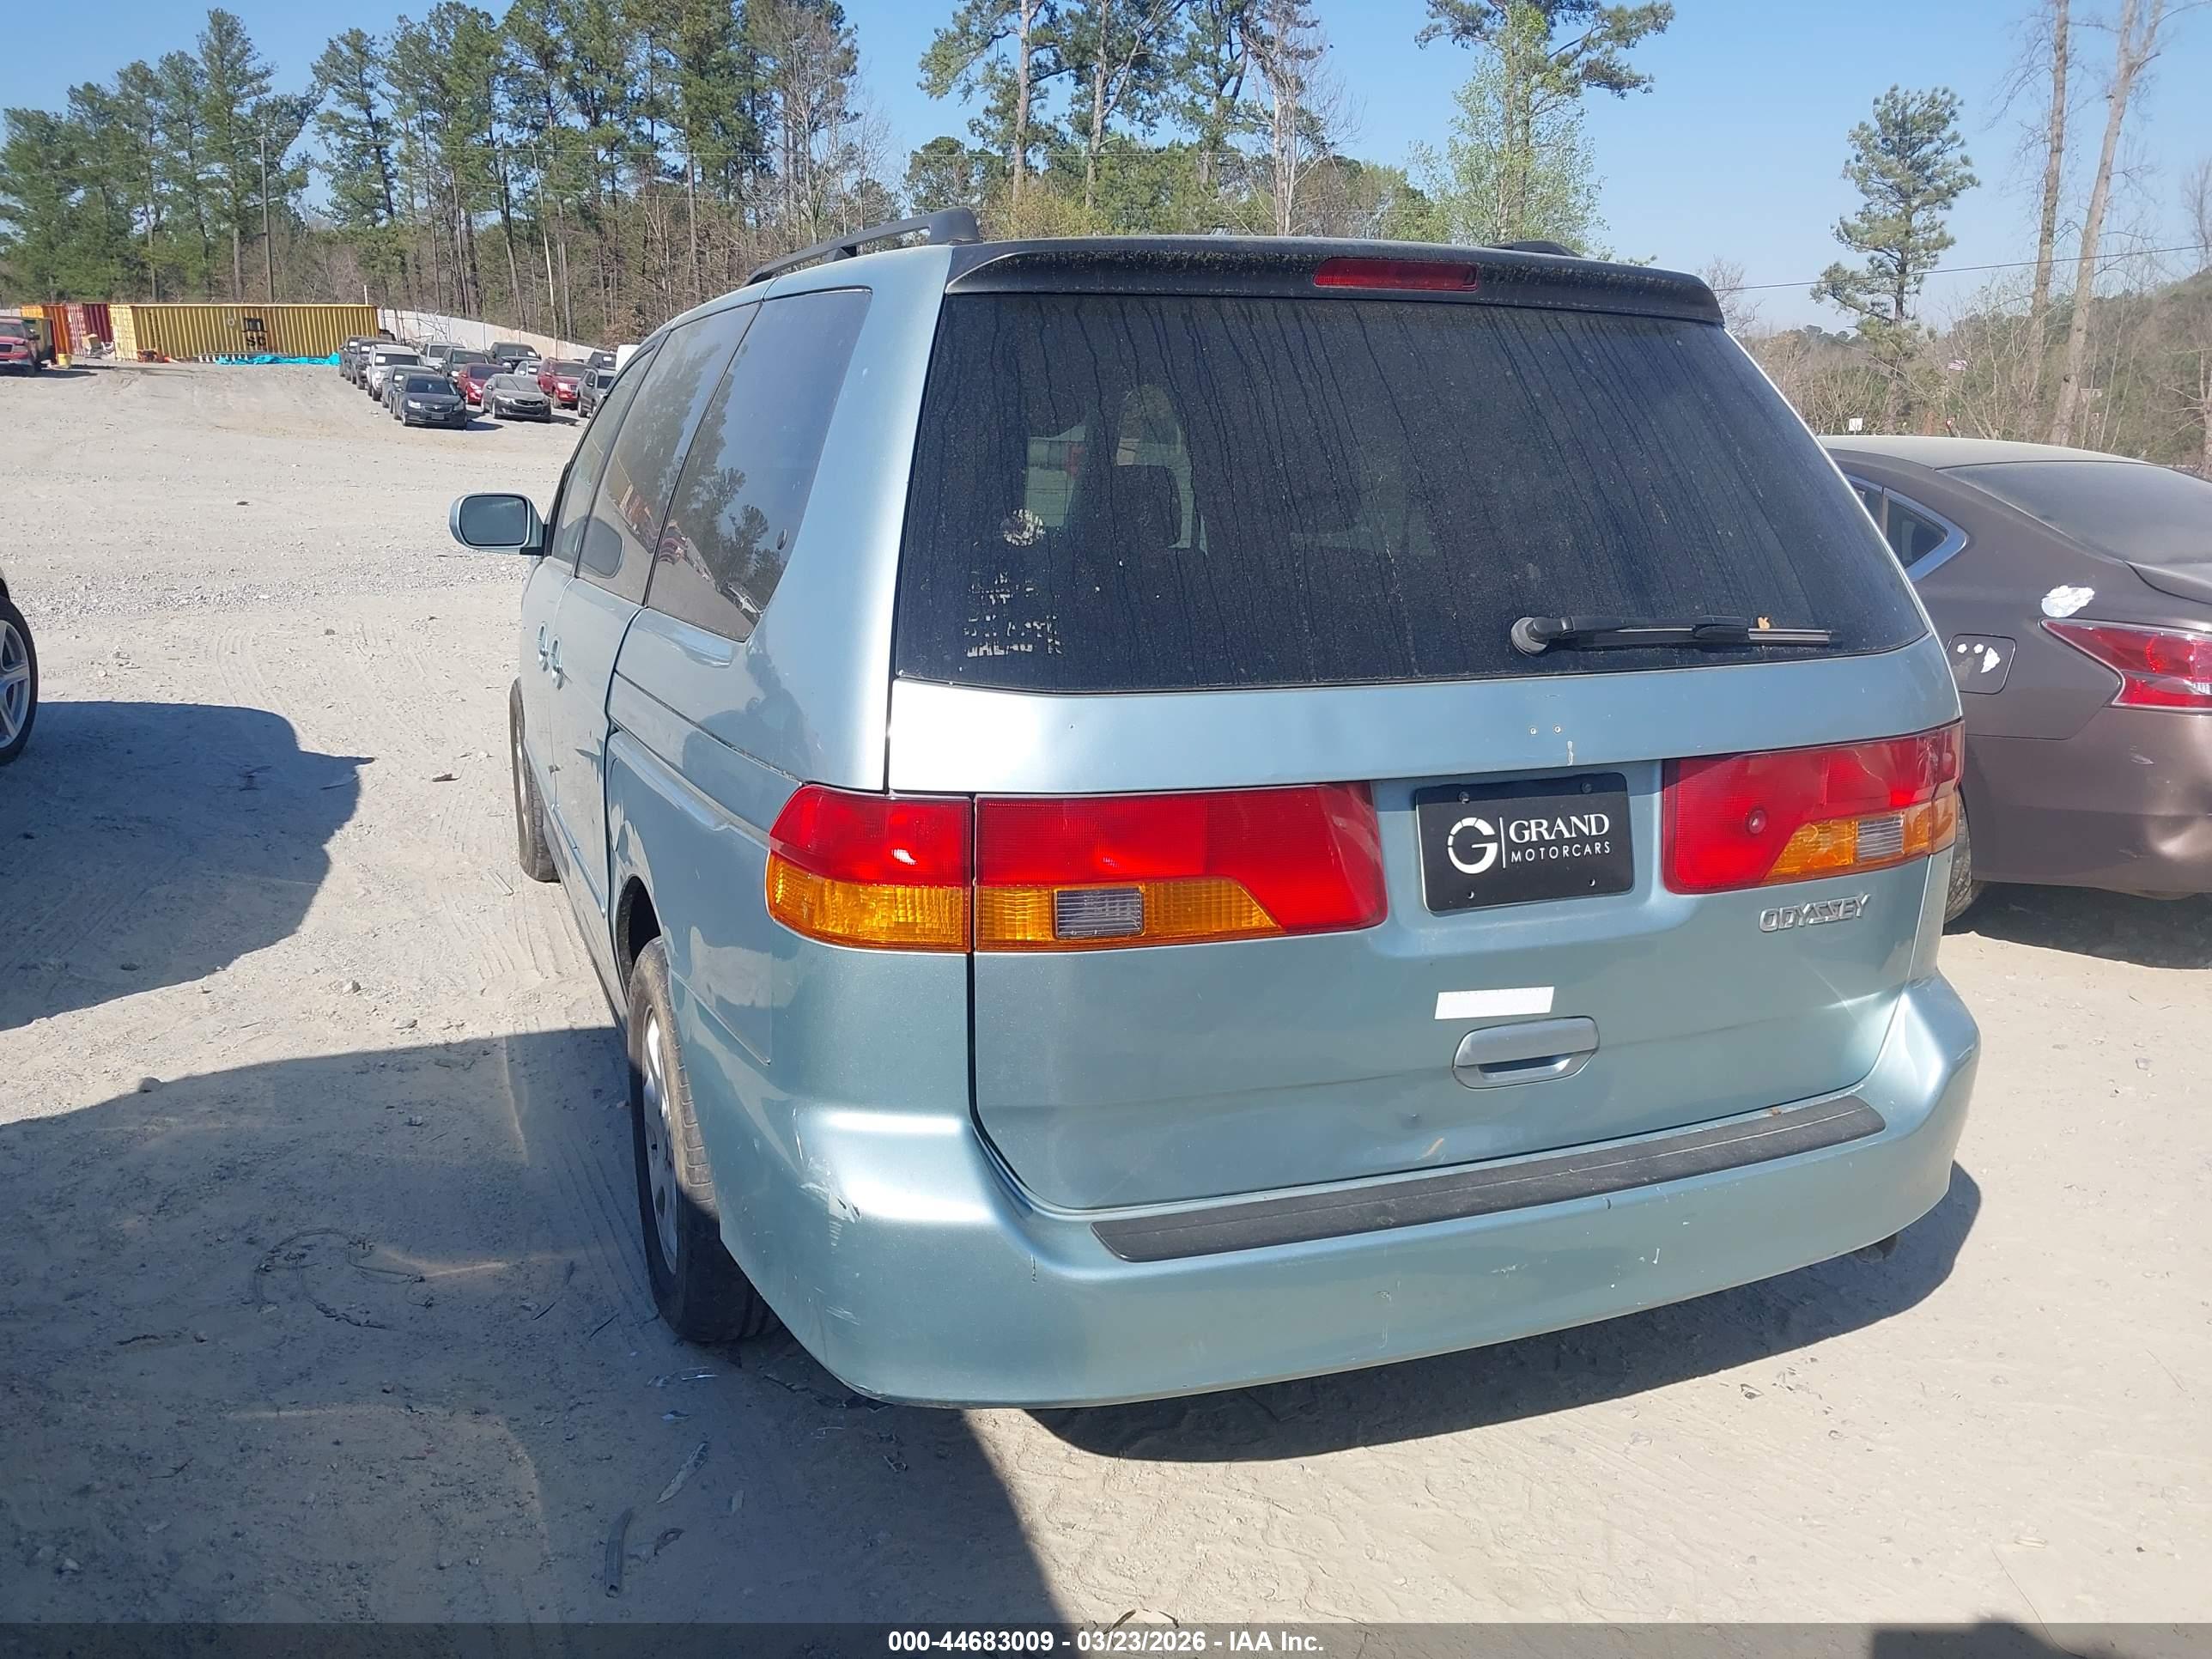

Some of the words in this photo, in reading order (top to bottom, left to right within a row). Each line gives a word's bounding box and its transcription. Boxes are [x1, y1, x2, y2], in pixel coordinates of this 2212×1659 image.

[1509, 813, 1610, 843] GRAND
[1510, 841, 1611, 863] MOTORCARS
[1759, 893, 1870, 932] ODYSSEY
